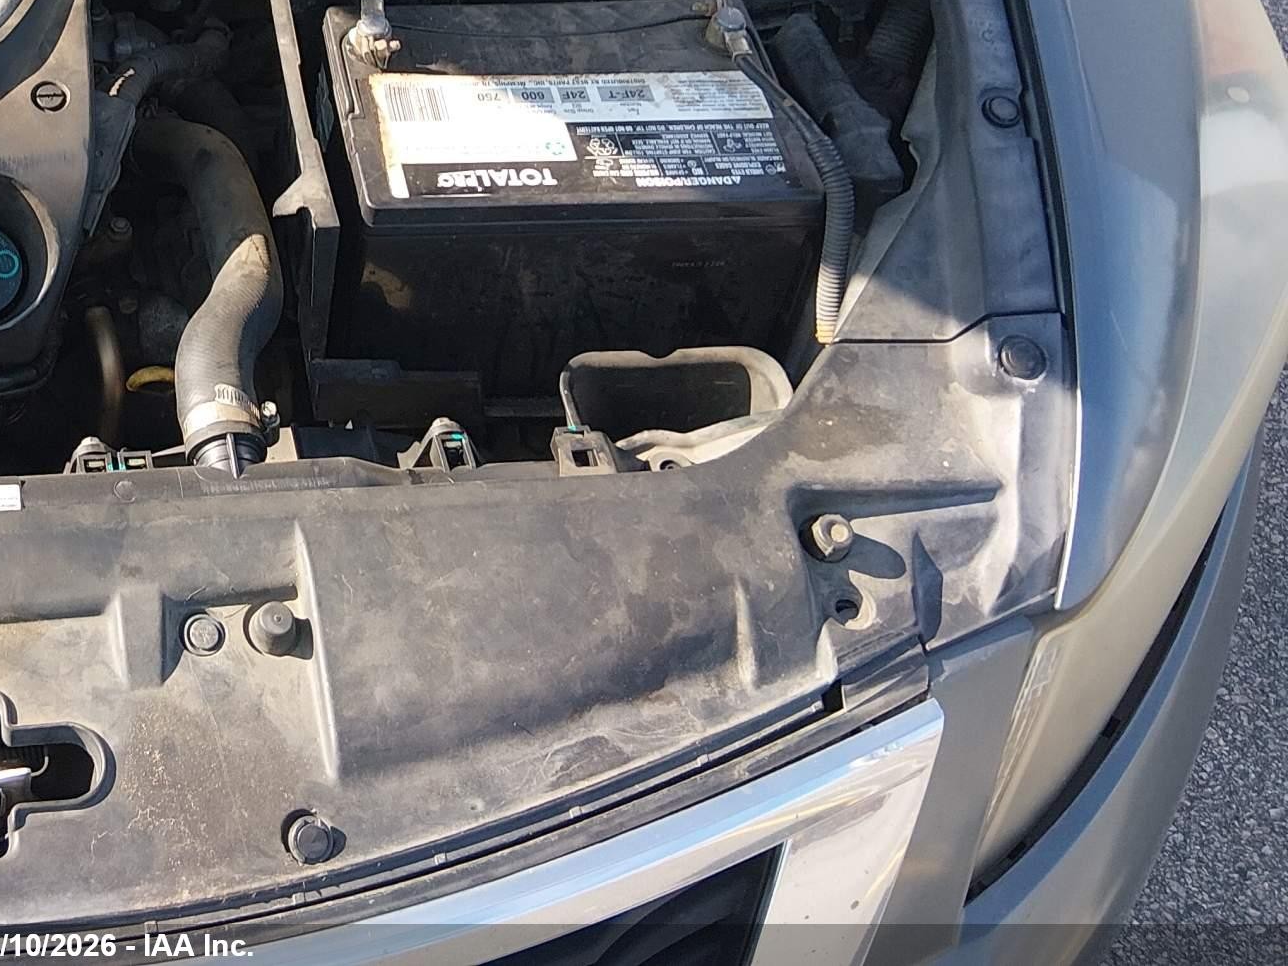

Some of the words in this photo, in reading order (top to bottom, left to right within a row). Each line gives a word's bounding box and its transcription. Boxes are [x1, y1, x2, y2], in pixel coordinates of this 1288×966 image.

[477, 93, 500, 101] 750
[521, 91, 545, 99] 600
[561, 90, 585, 99] 24F
[608, 89, 645, 99] 24F-T
